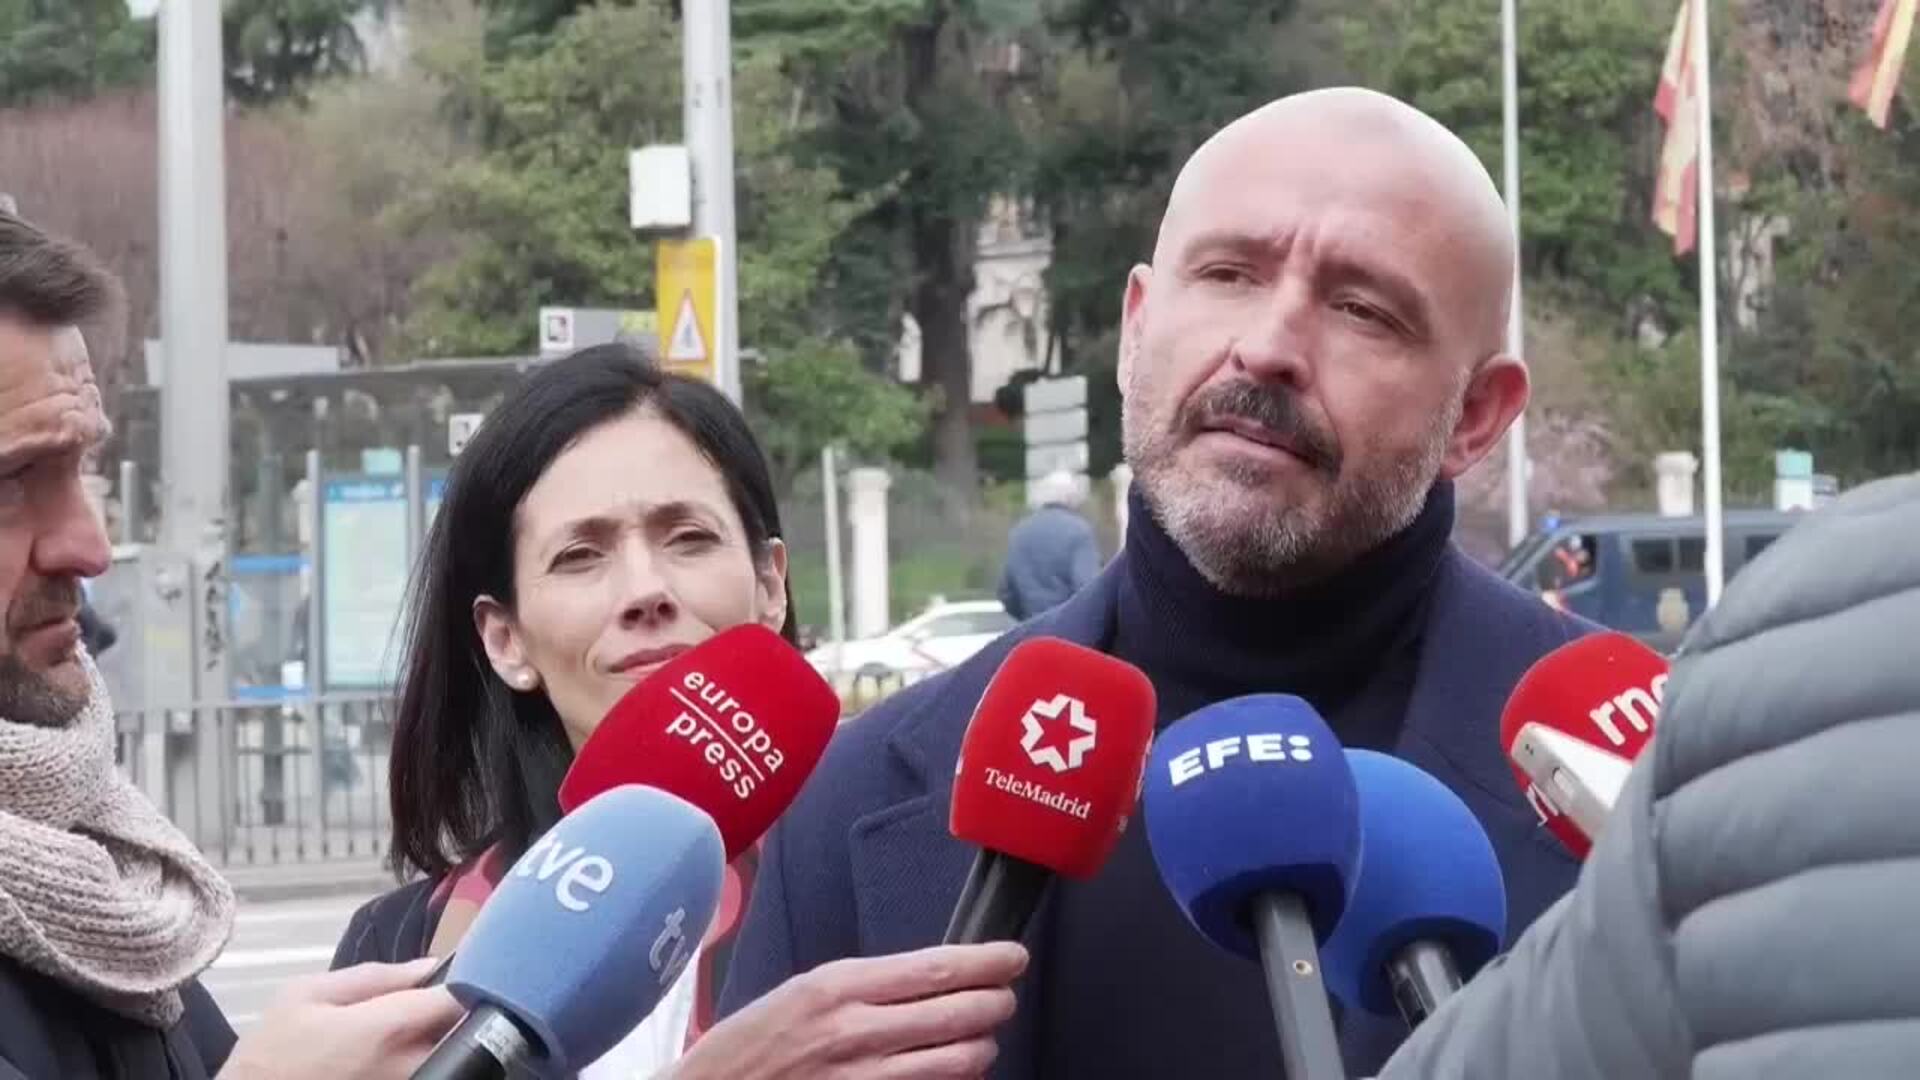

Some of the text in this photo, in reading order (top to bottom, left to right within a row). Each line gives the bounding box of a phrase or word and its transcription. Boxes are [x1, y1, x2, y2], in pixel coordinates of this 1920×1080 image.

[666, 711, 756, 799] press
[684, 671, 784, 773] europa
[985, 767, 1091, 819] TeleMadrid
